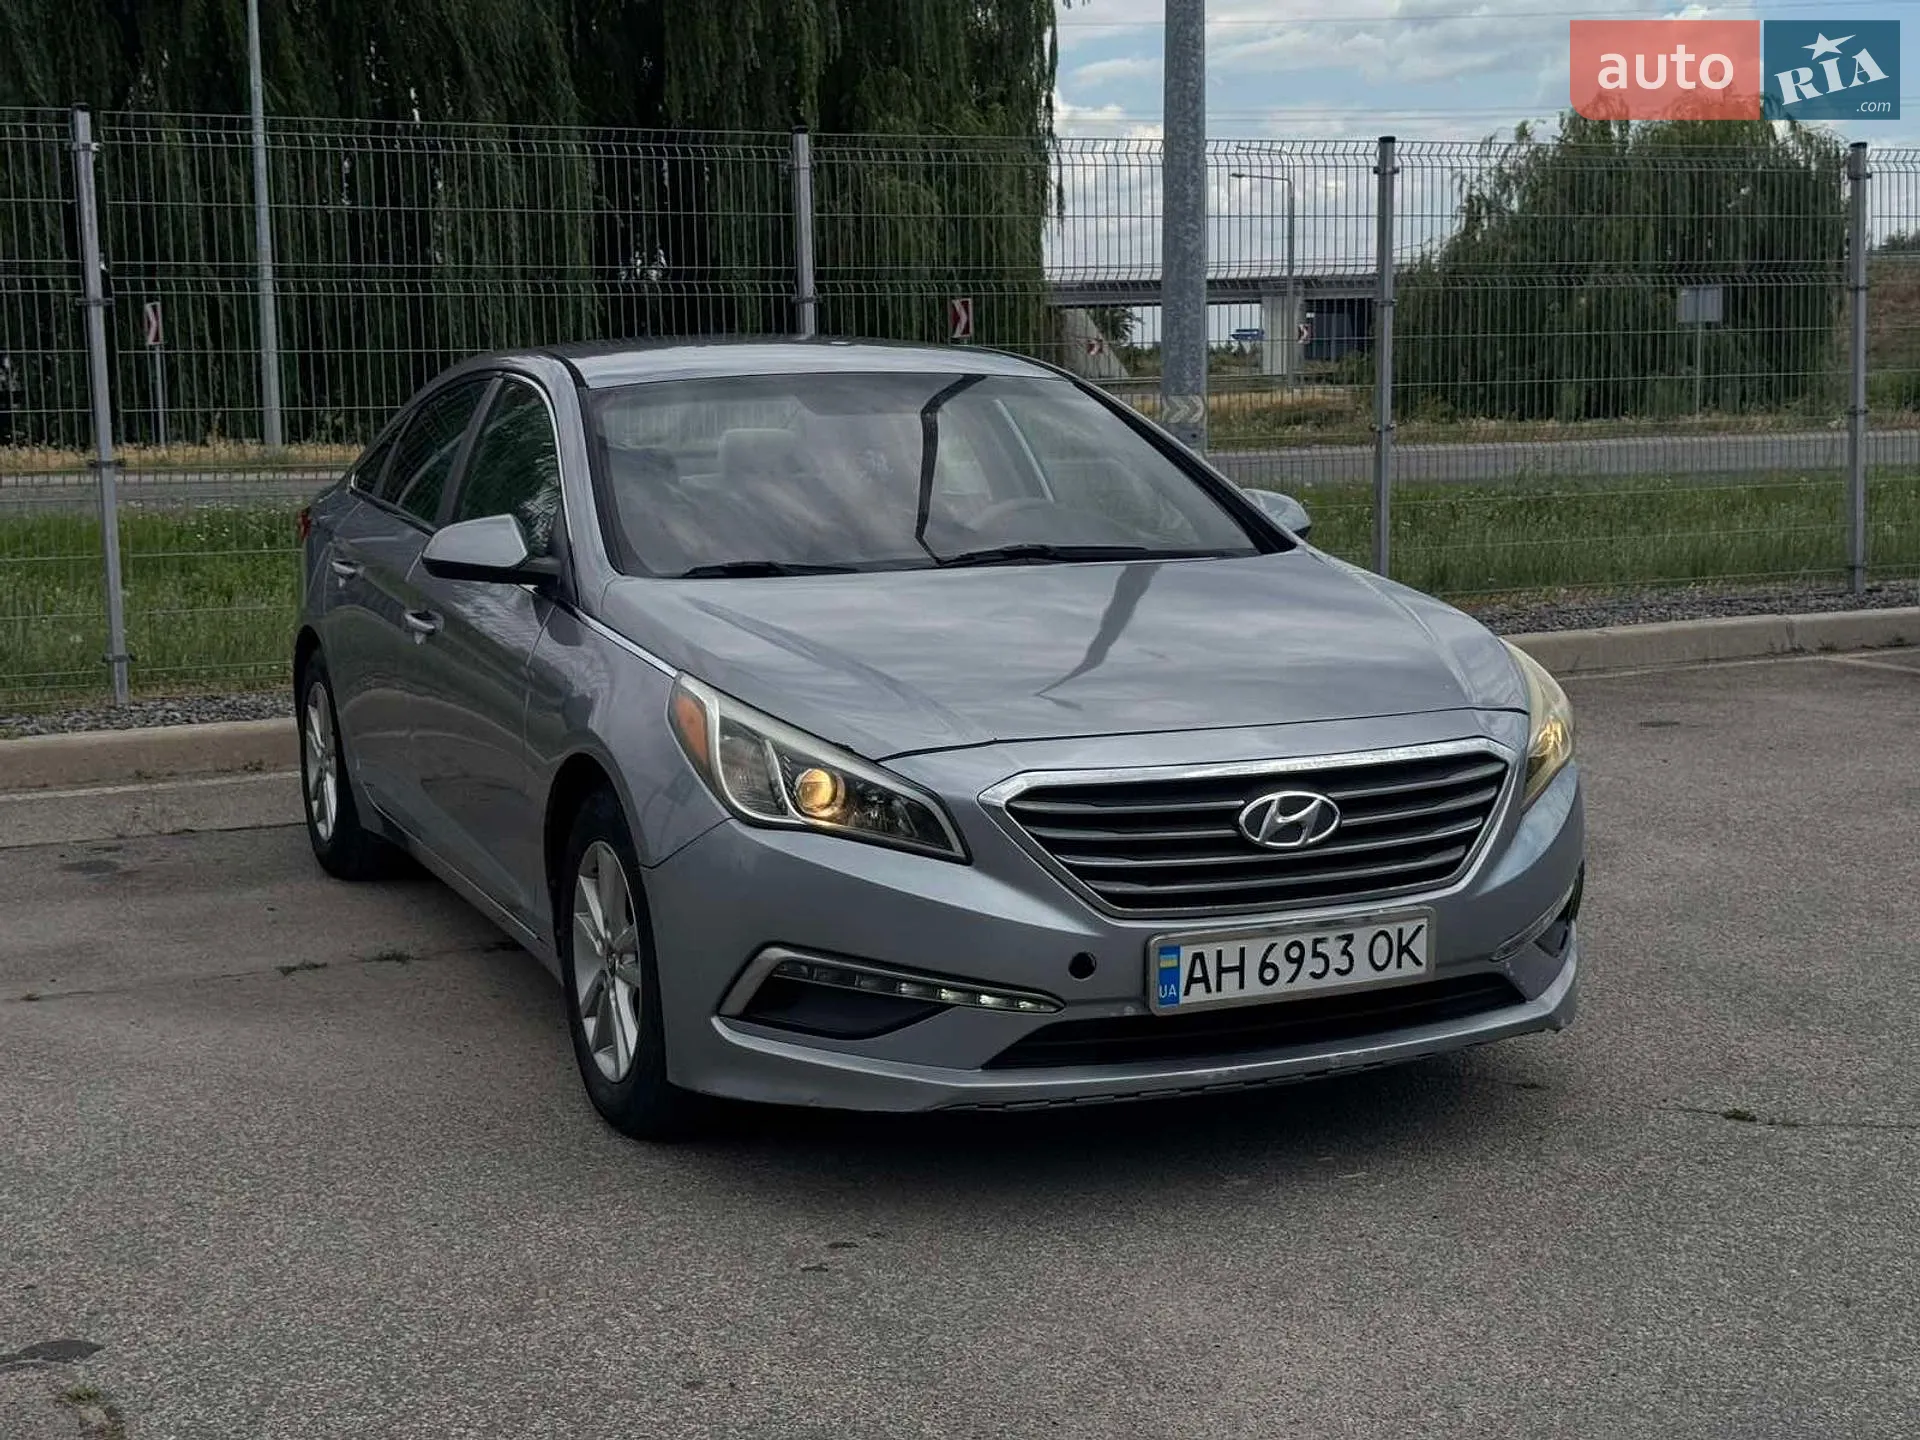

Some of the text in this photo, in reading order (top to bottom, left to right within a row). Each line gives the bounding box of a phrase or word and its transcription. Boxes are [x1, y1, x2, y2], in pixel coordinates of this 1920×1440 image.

[1183, 924, 1425, 996] AH 6953 OK
[1159, 983, 1177, 999] UA
